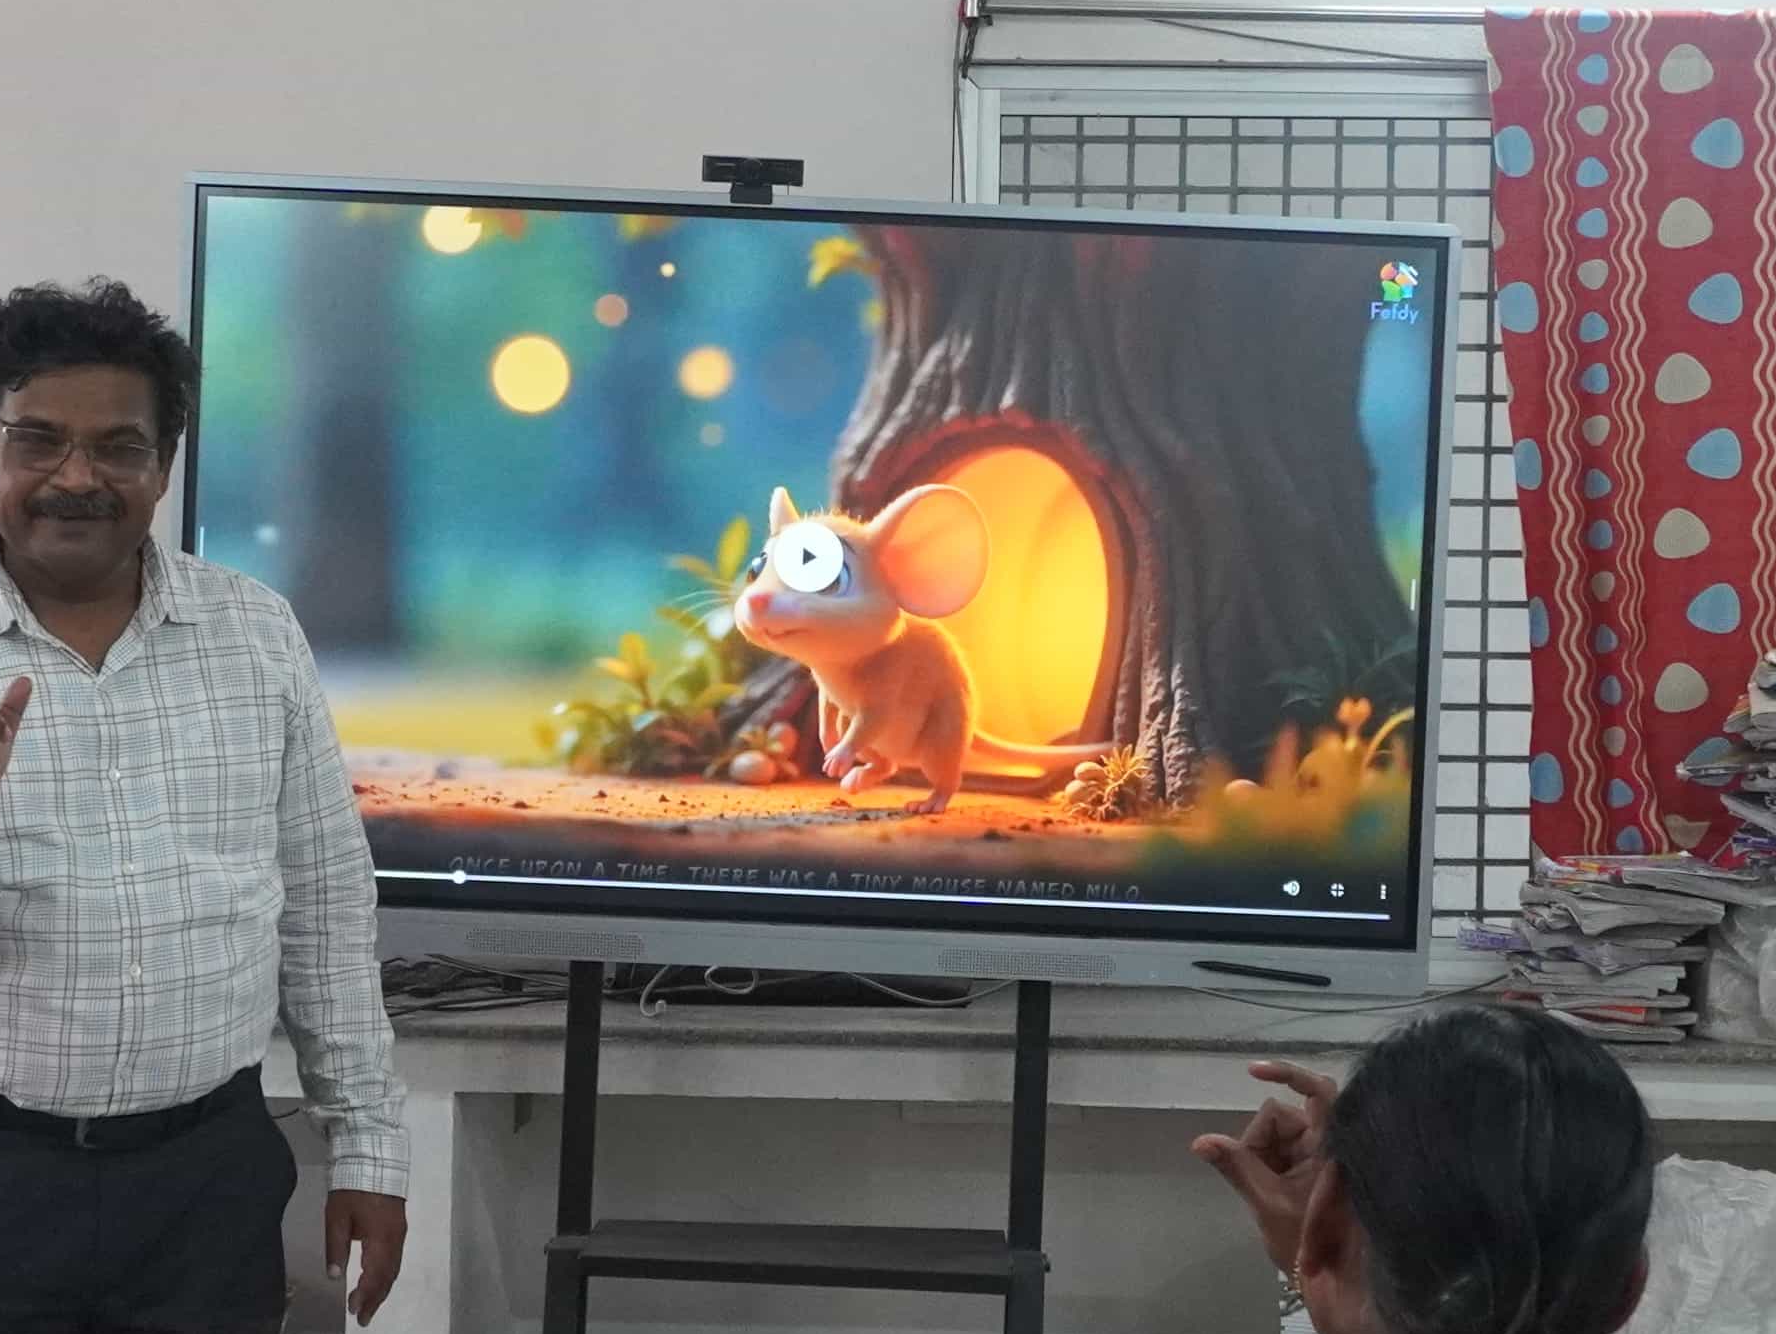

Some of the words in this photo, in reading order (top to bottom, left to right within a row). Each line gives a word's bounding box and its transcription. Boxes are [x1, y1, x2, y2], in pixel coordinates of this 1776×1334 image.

[591, 861, 606, 878] A
[688, 866, 760, 885] THERE
[826, 871, 840, 888] A
[850, 873, 903, 892] TINY
[911, 876, 987, 895] MOUSE
[997, 880, 1076, 900] NAMED
